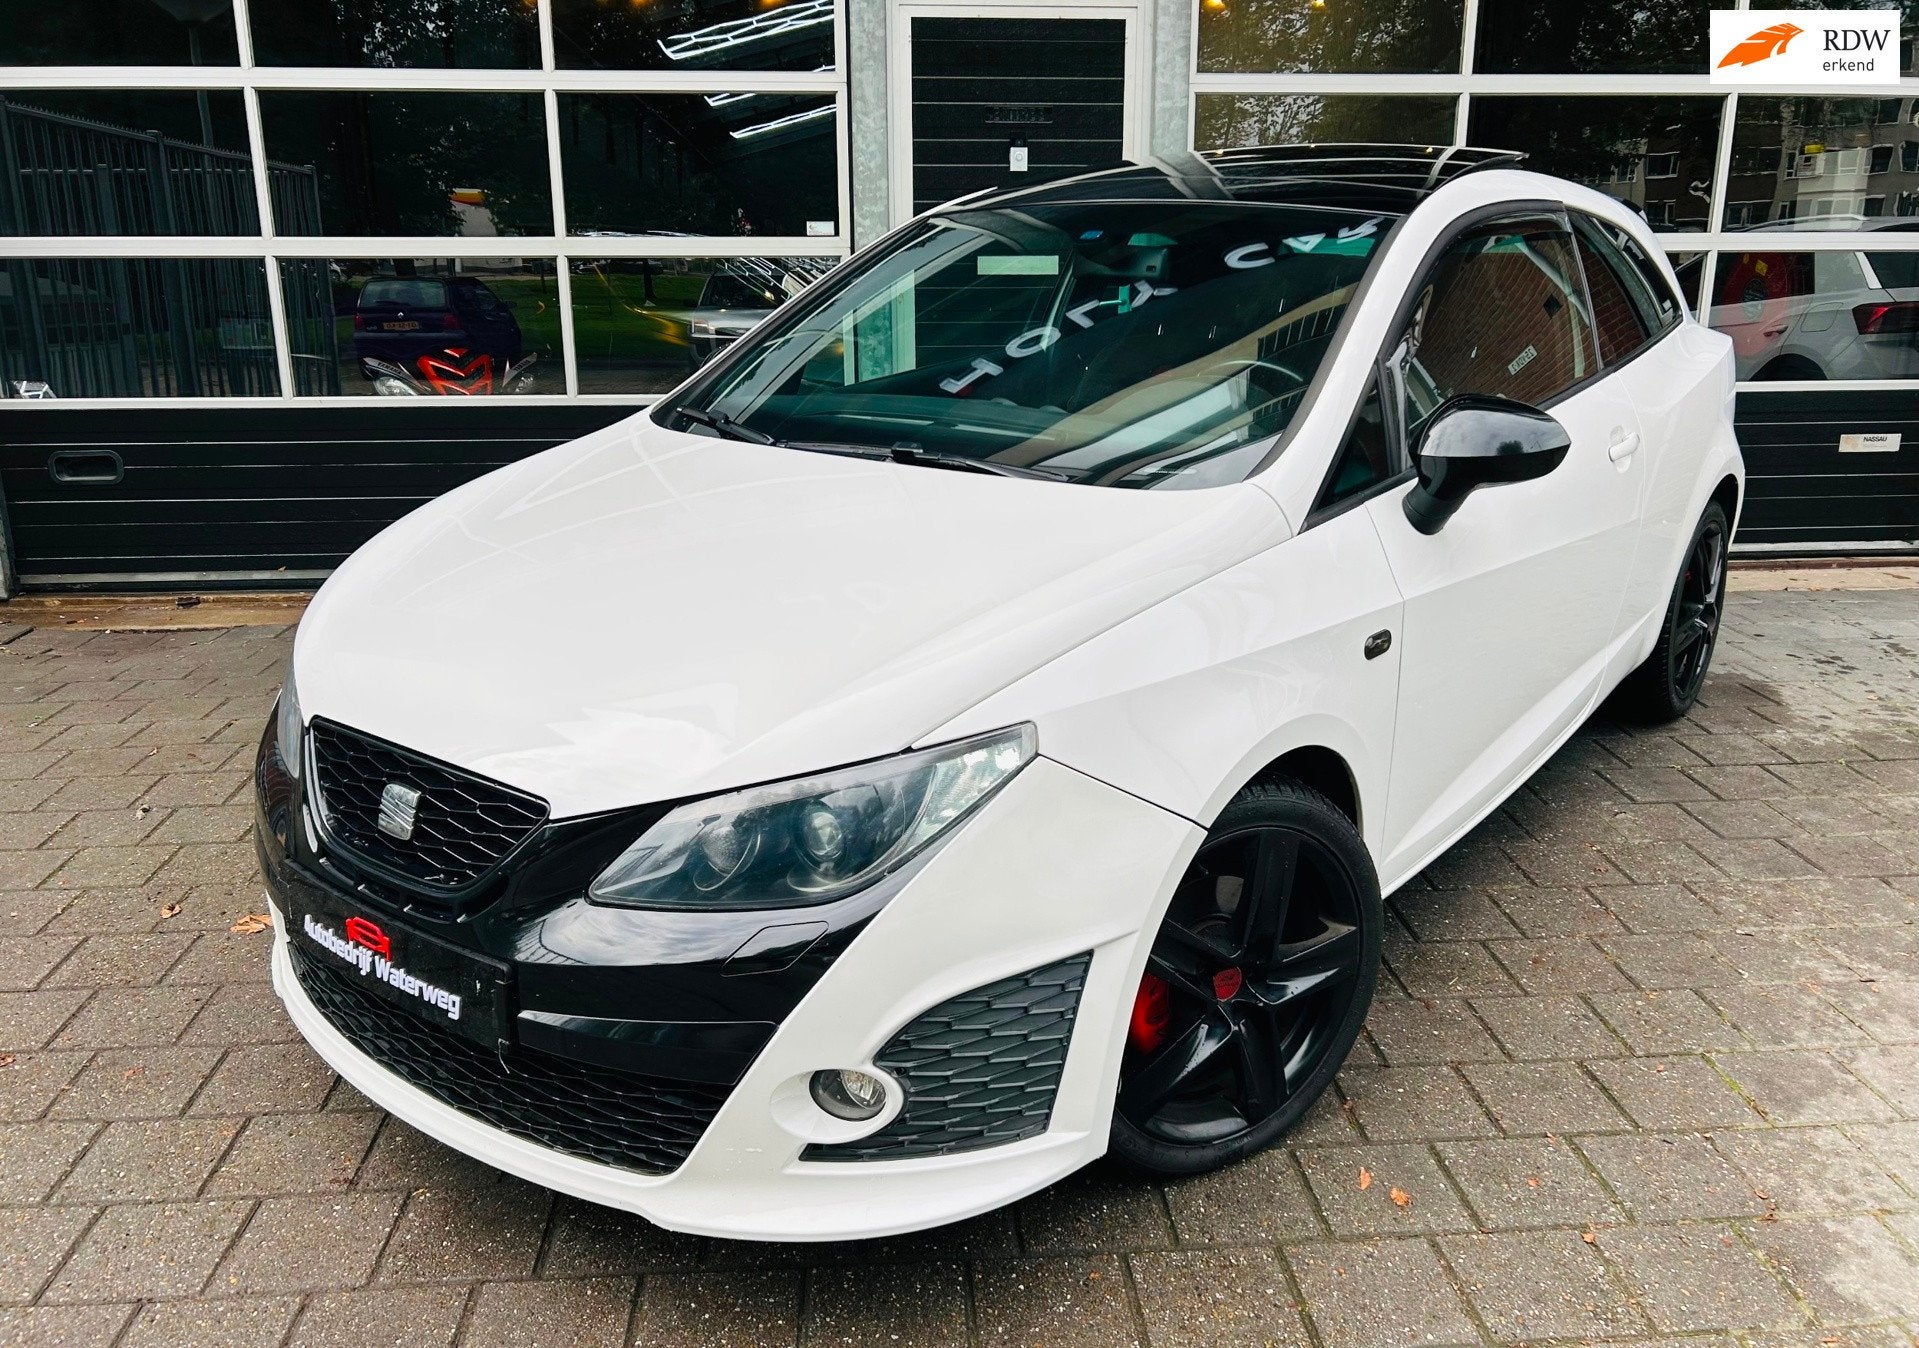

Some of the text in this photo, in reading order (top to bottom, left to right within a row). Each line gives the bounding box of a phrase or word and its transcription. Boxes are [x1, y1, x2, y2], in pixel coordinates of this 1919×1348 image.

[377, 362, 402, 375] YAMAHA
[304, 914, 463, 1020] Autobedrijf Waterweg
